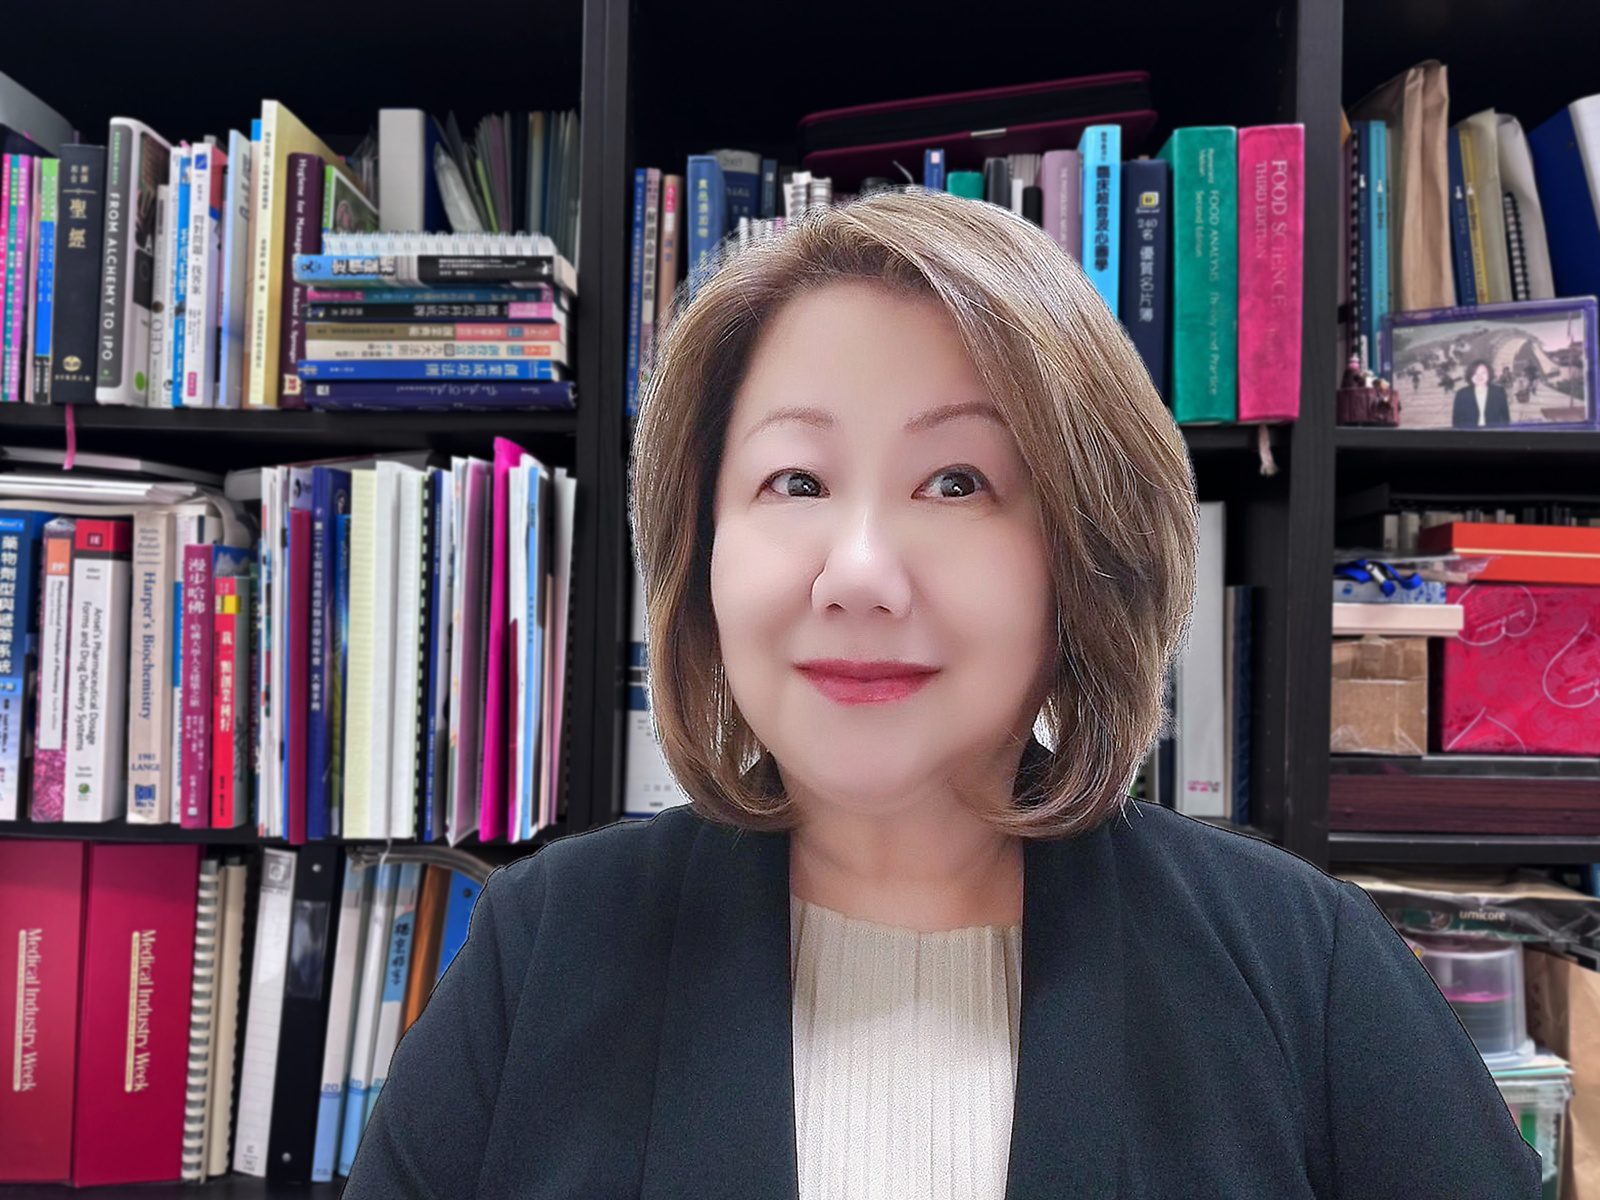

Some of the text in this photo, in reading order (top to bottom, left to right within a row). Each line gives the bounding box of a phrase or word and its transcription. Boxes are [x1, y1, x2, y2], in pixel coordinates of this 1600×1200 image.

[296, 158, 307, 197] Hygiene
[1255, 160, 1267, 203] THIRD
[296, 200, 305, 214] for
[1209, 190, 1220, 226] FOOD
[1271, 160, 1288, 306] FOOD SCIENCE
[102, 192, 120, 361] FROM ALCHEMY TO IPO
[1209, 229, 1220, 281] ANALYSIS
[291, 319, 299, 328] A.
[292, 287, 301, 316] Richard
[1208, 353, 1220, 395] Practice
[188, 558, 206, 614] 漫步哈佛
[138, 571, 156, 720] Harper's Biochemistry
[75, 601, 92, 751] Forms and Drug Delivery Systems
[86, 607, 103, 746] Ansel's Pharmaceutical Dosage
[1459, 907, 1506, 921] umicore
[21, 928, 43, 1092] Medical Industry Week
[133, 929, 156, 1092] Medical Industry Week
